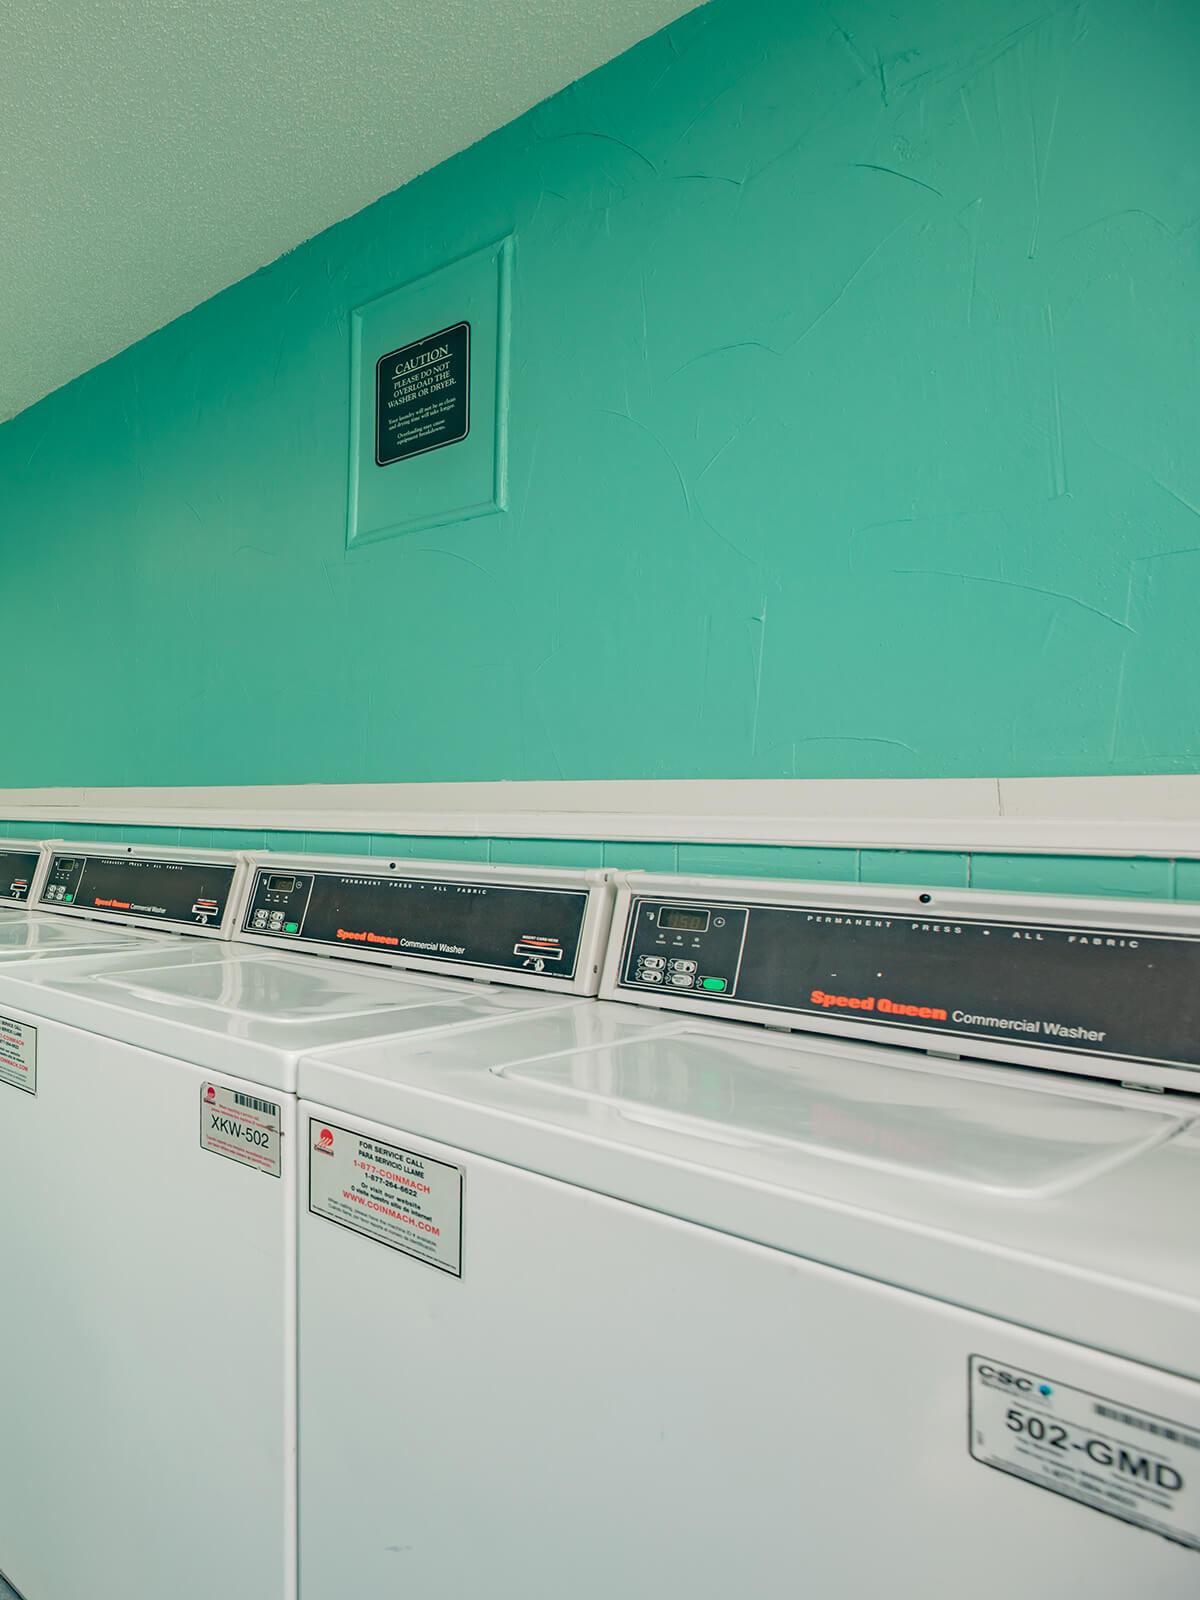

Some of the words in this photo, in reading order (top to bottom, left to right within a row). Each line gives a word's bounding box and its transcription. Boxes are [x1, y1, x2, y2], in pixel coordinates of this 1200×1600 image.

[395, 344, 449, 375] CAUTION
[394, 374, 420, 389] PLEASE
[421, 369, 432, 379] DO
[434, 361, 450, 374] NOT
[394, 378, 433, 398] OVERLOAD
[435, 370, 450, 382] THE
[388, 393, 417, 408] WASHER
[418, 388, 429, 397] OR
[431, 378, 456, 393] DRYER.
[336, 929, 367, 941] Speed
[368, 932, 399, 945] Queen
[400, 938, 439, 950] Commercial
[439, 943, 466, 955] Washer
[807, 915, 892, 928] PERMANENT
[912, 923, 962, 934] PRESS
[1013, 931, 1044, 941] ALL
[1068, 935, 1139, 949] FABRIC
[810, 990, 875, 1011] Speed
[877, 998, 947, 1021] Queen
[952, 1010, 1041, 1033] Commercial
[1043, 1021, 1107, 1042] Washer
[212, 1115, 269, 1149] XKW-502
[359, 1150, 374, 1160] PARA
[375, 1155, 402, 1170] SERVICIO
[404, 1165, 424, 1179] LLAME
[360, 1140, 373, 1151] FOR
[374, 1145, 404, 1161] SERVICE
[406, 1157, 424, 1169] CALL
[354, 1160, 430, 1193] 1-877-COINMACH
[370, 1186, 383, 1195] visit
[397, 1197, 421, 1210] website
[343, 1190, 440, 1237] WWW.COINMACH.COM
[979, 1365, 1033, 1392] CSC
[1006, 1408, 1184, 1492] 502-GMD
